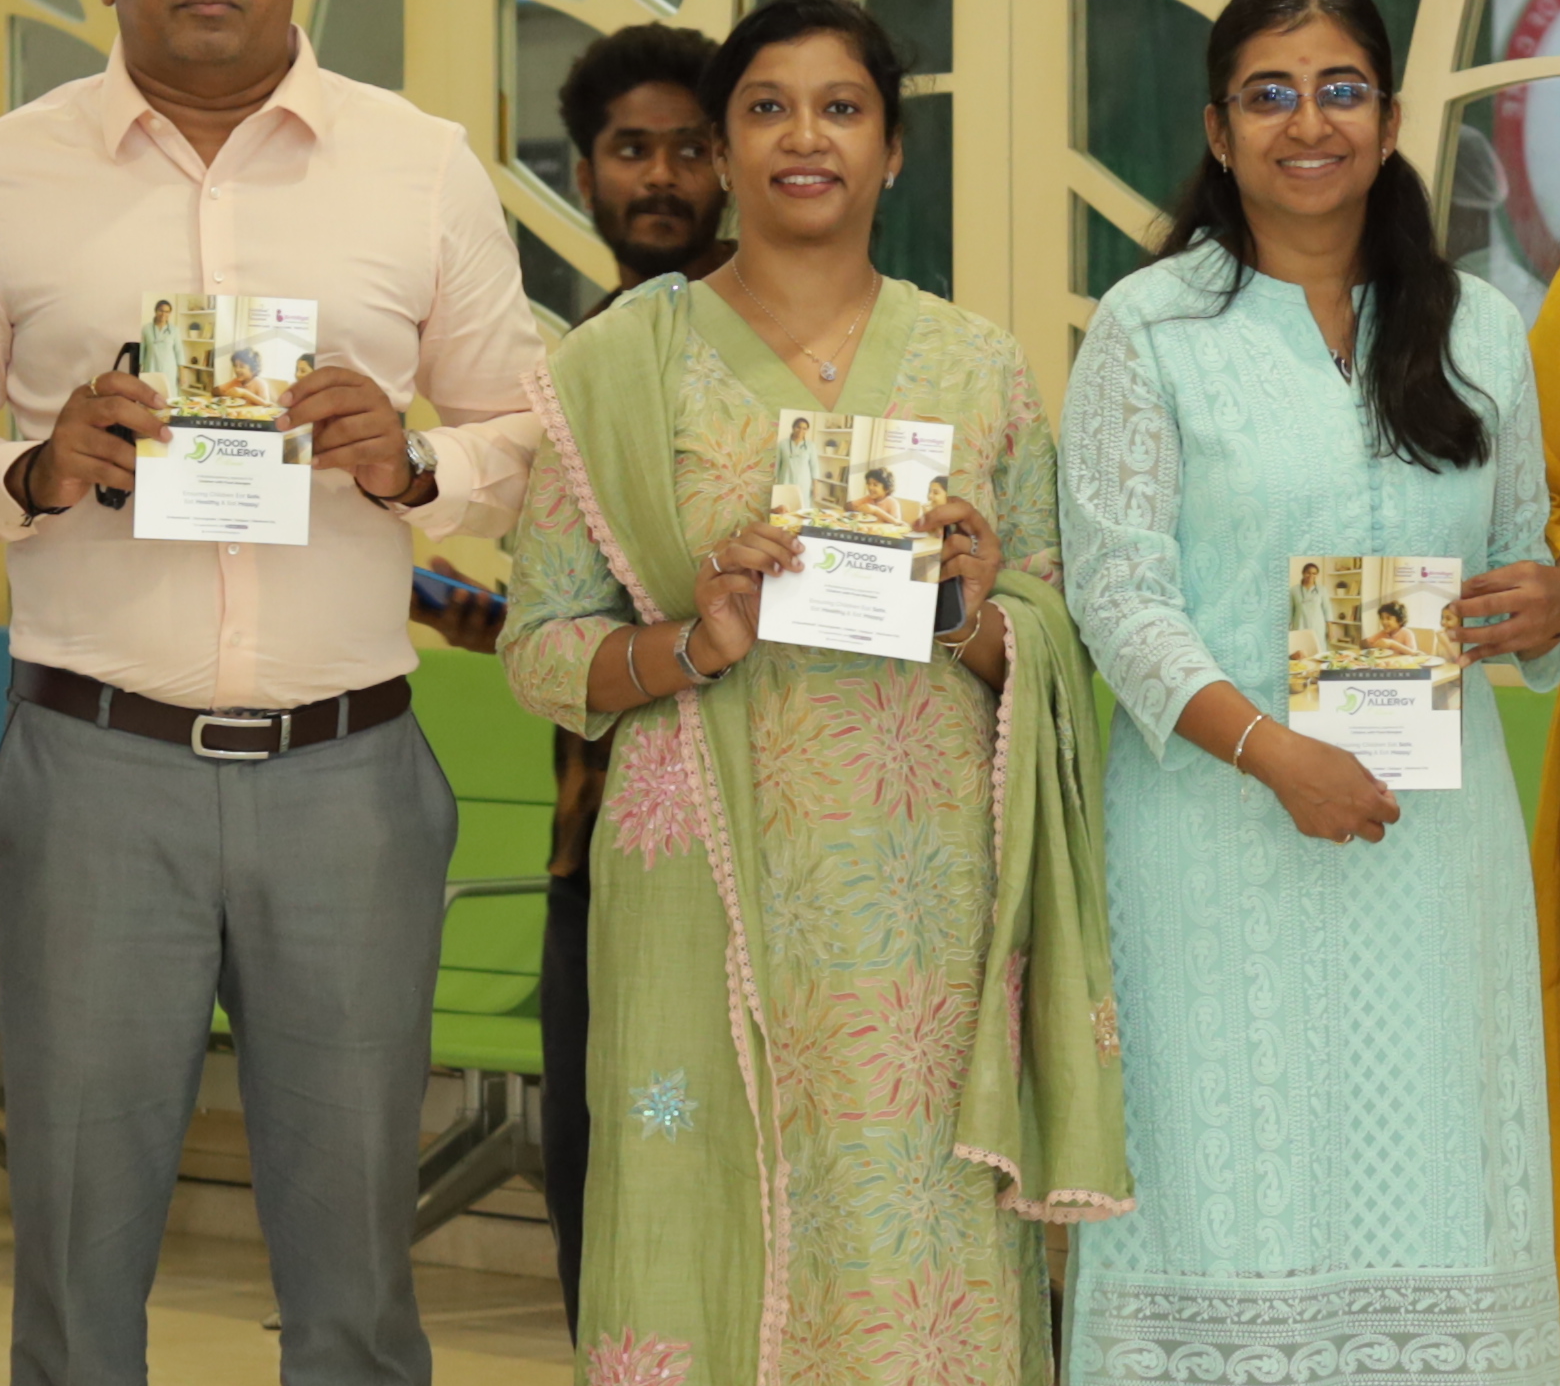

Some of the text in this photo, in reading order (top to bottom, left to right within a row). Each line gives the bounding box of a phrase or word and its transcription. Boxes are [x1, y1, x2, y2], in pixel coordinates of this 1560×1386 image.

[217, 438, 248, 448] FOOD
[216, 447, 266, 459] ALLERGY
[846, 551, 877, 563] FOOD
[845, 560, 894, 574] ALLERGY
[1366, 688, 1398, 697] FOOD
[1366, 697, 1415, 707] ALLERGY
